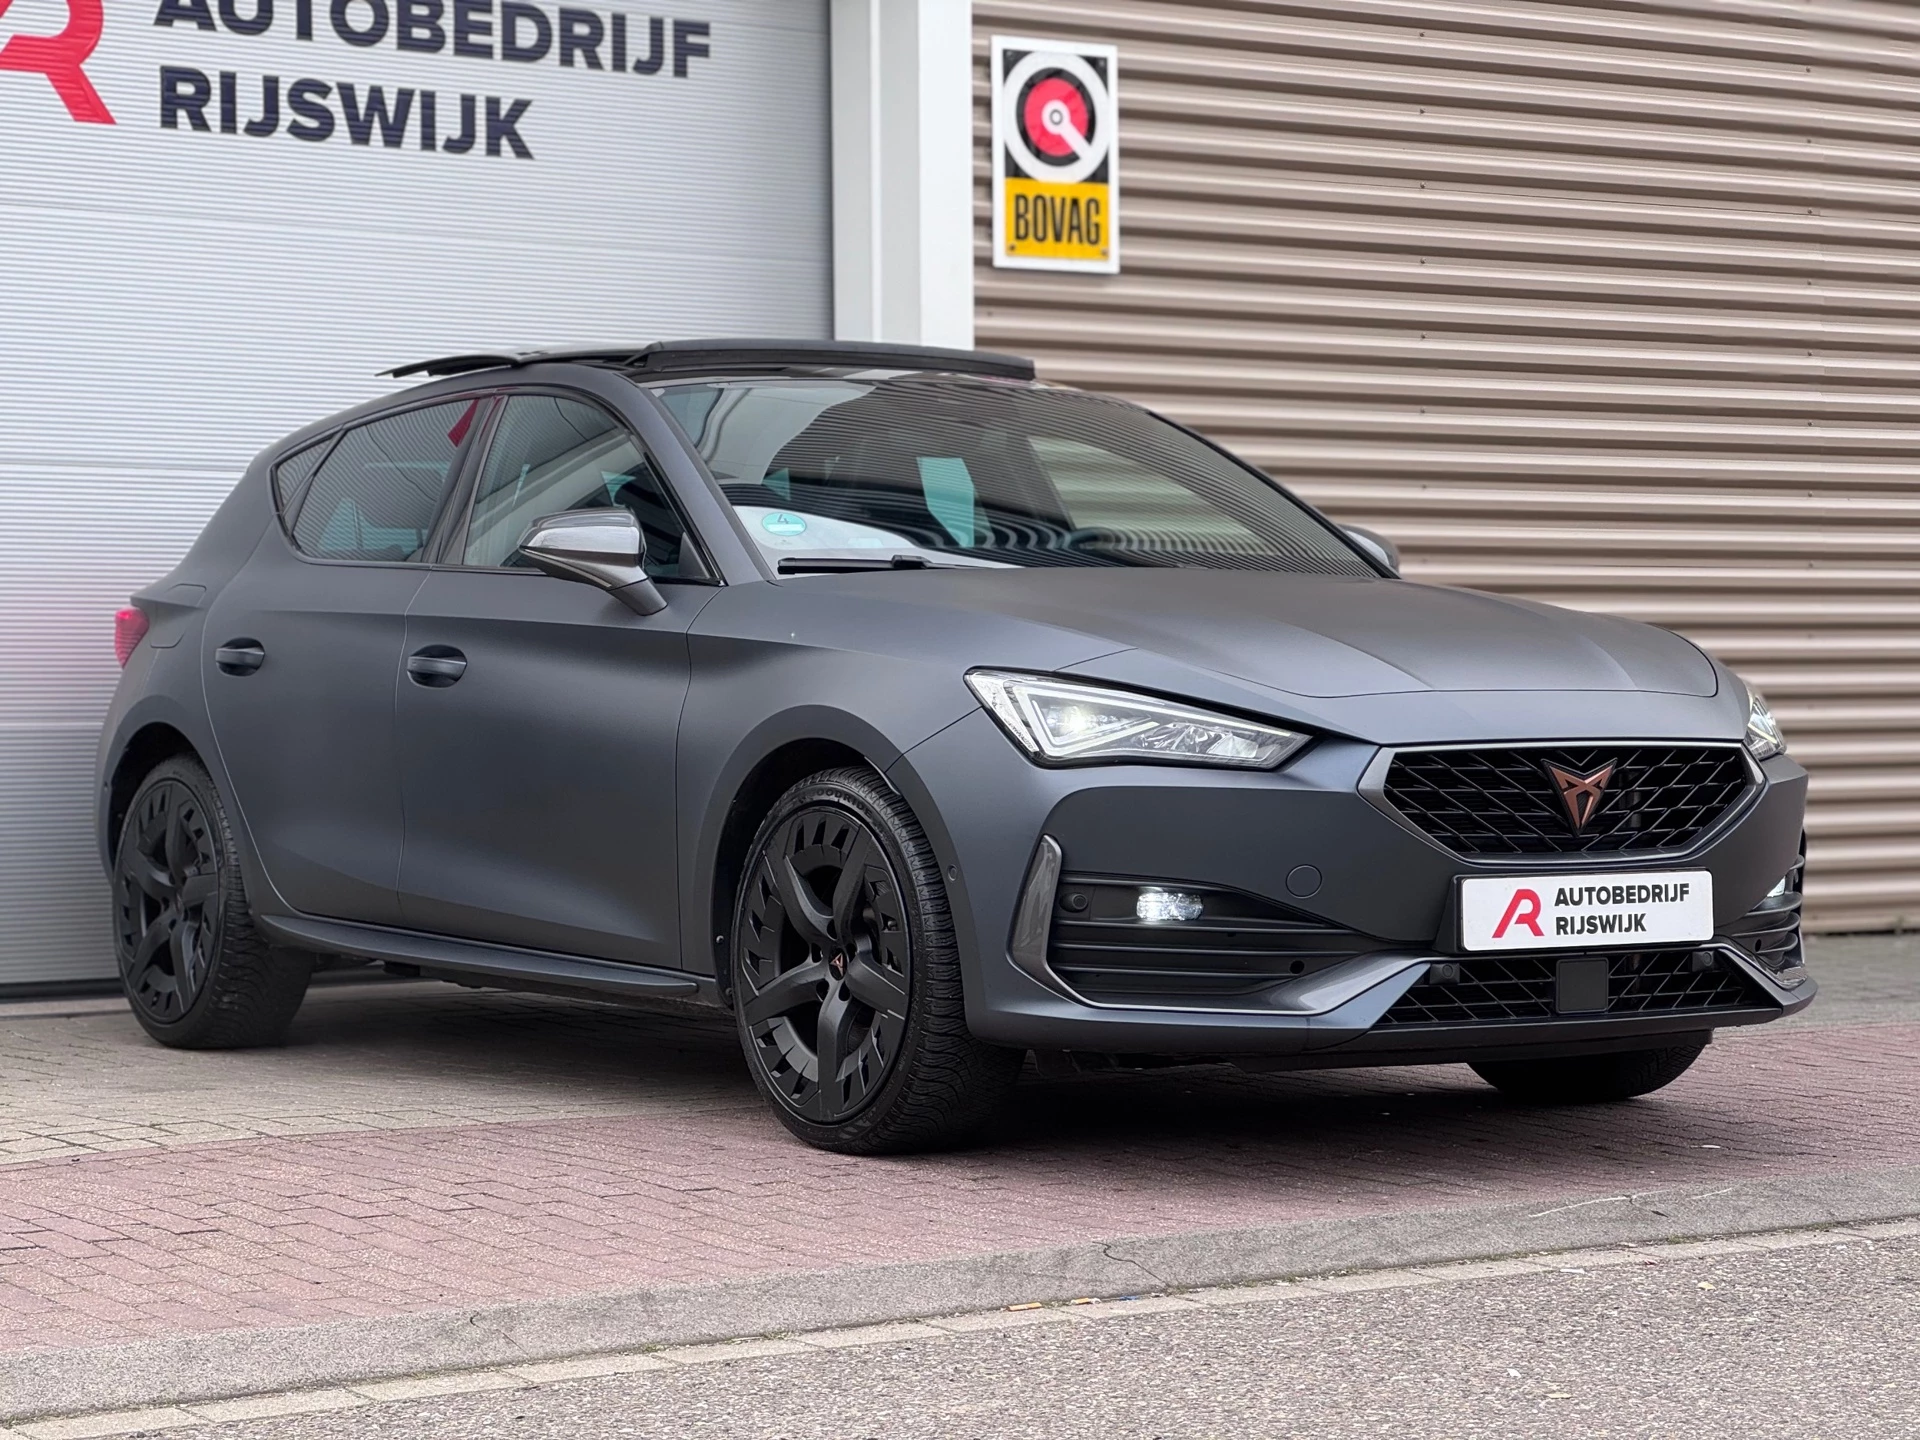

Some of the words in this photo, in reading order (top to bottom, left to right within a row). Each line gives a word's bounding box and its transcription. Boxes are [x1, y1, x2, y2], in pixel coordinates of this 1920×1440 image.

[160, 65, 535, 160] RIJSWIJK
[1014, 193, 1101, 246] BOVAG
[777, 513, 789, 524] 4
[811, 788, 873, 819] OODRIDE
[1554, 883, 1690, 907] AUTOBEDRIJF
[1555, 913, 1647, 936] RIJSWIJK
